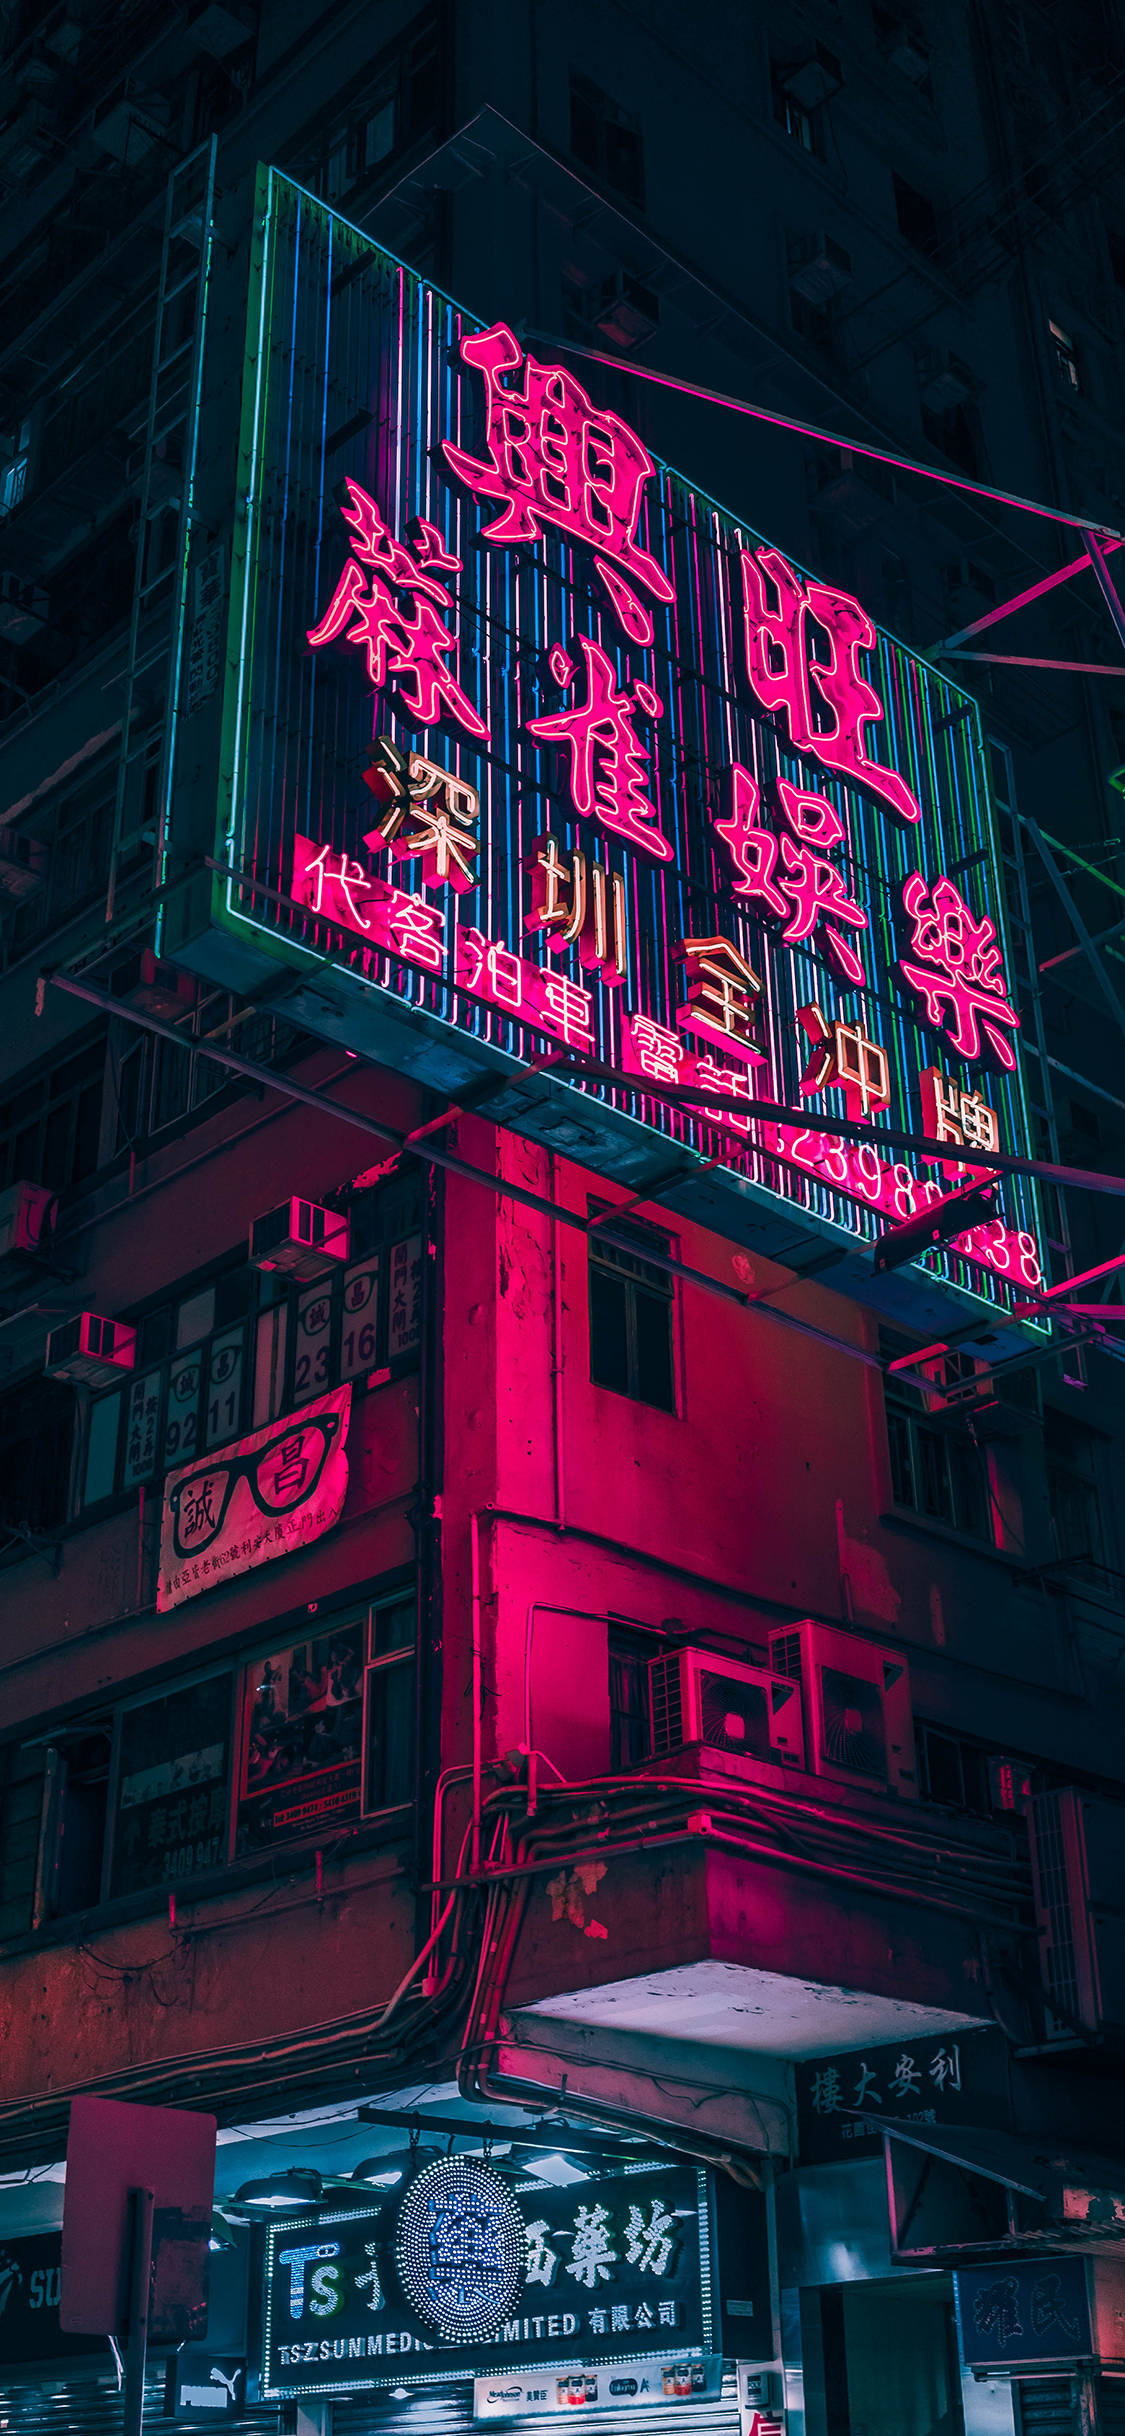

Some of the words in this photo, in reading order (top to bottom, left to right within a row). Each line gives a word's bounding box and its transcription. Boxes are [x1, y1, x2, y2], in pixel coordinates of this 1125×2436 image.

[304, 844, 596, 1046] 代客泊車
[295, 1345, 330, 1393] 23
[343, 1323, 375, 1368] 16
[165, 1411, 197, 1457] 92
[209, 1390, 236, 1435] 11
[183, 1480, 216, 1540] 誠
[272, 1436, 311, 1497] 昌
[588, 2300, 676, 2334] 有限公司
